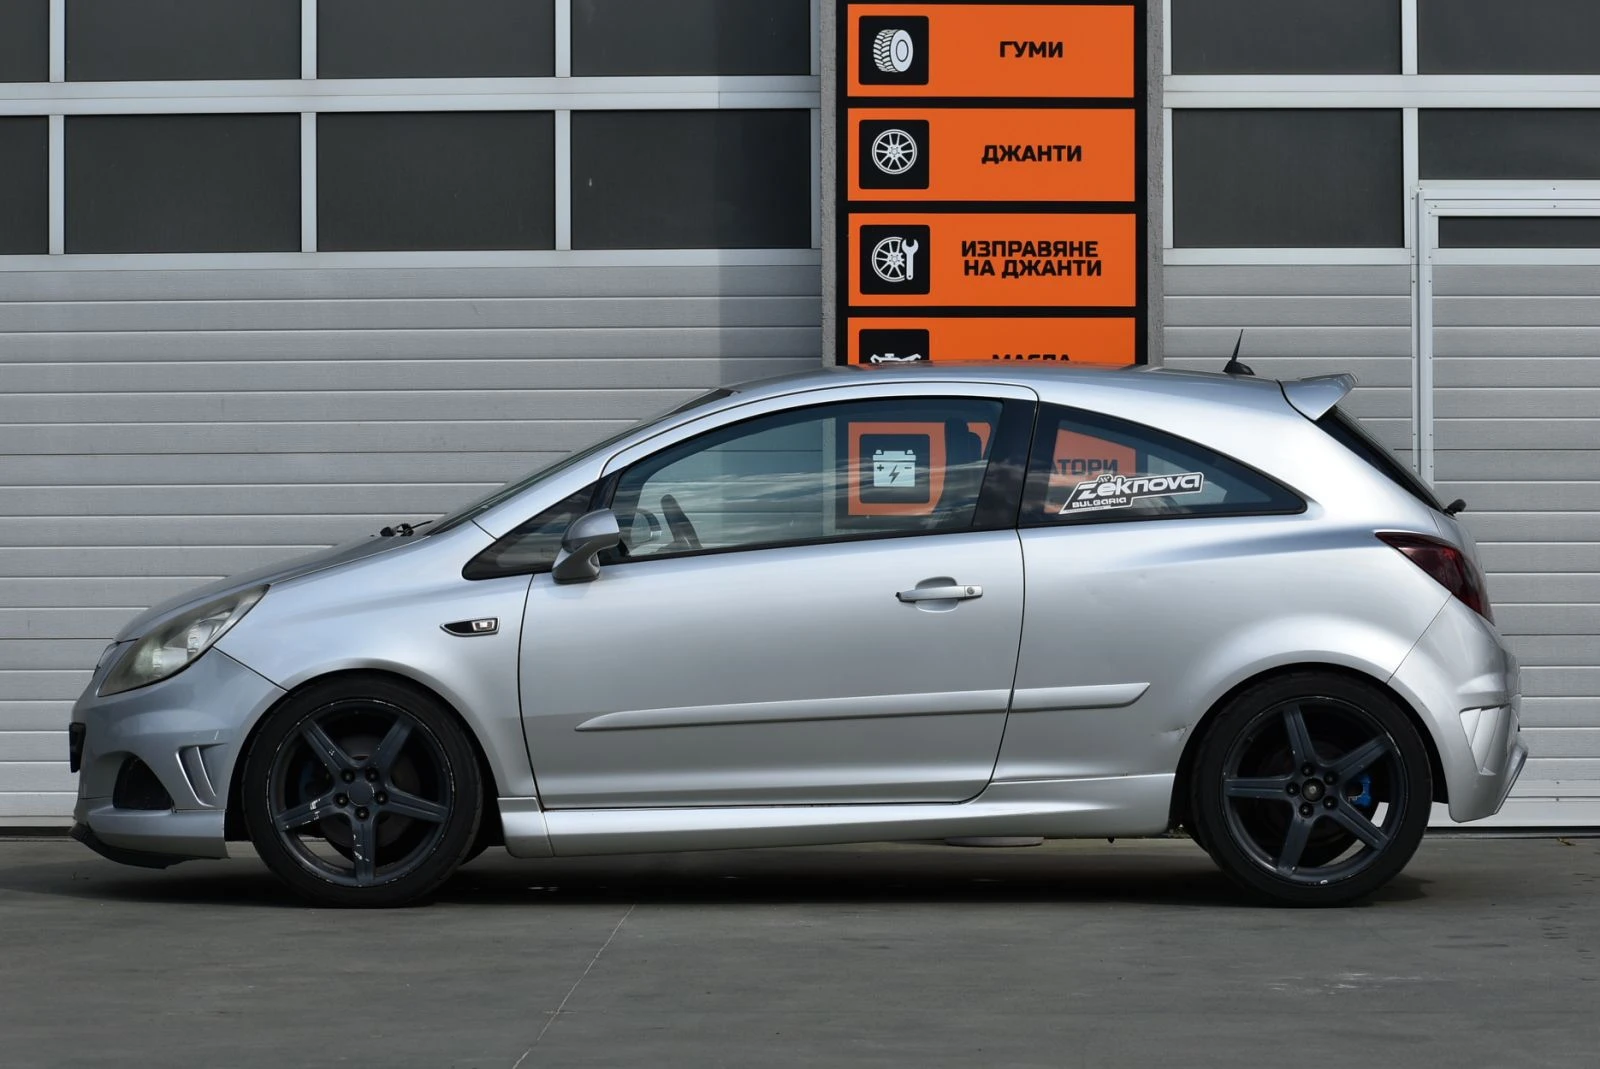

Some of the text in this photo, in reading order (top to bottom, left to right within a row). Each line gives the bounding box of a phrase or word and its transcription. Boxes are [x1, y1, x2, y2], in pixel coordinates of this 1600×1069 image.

[999, 40, 1064, 59] ГУМИ
[981, 144, 1082, 165] ДЖАНТИ
[961, 240, 1099, 258] ИЗПРАВЯНЕ
[963, 260, 1102, 279] НА ДЖАНТИ
